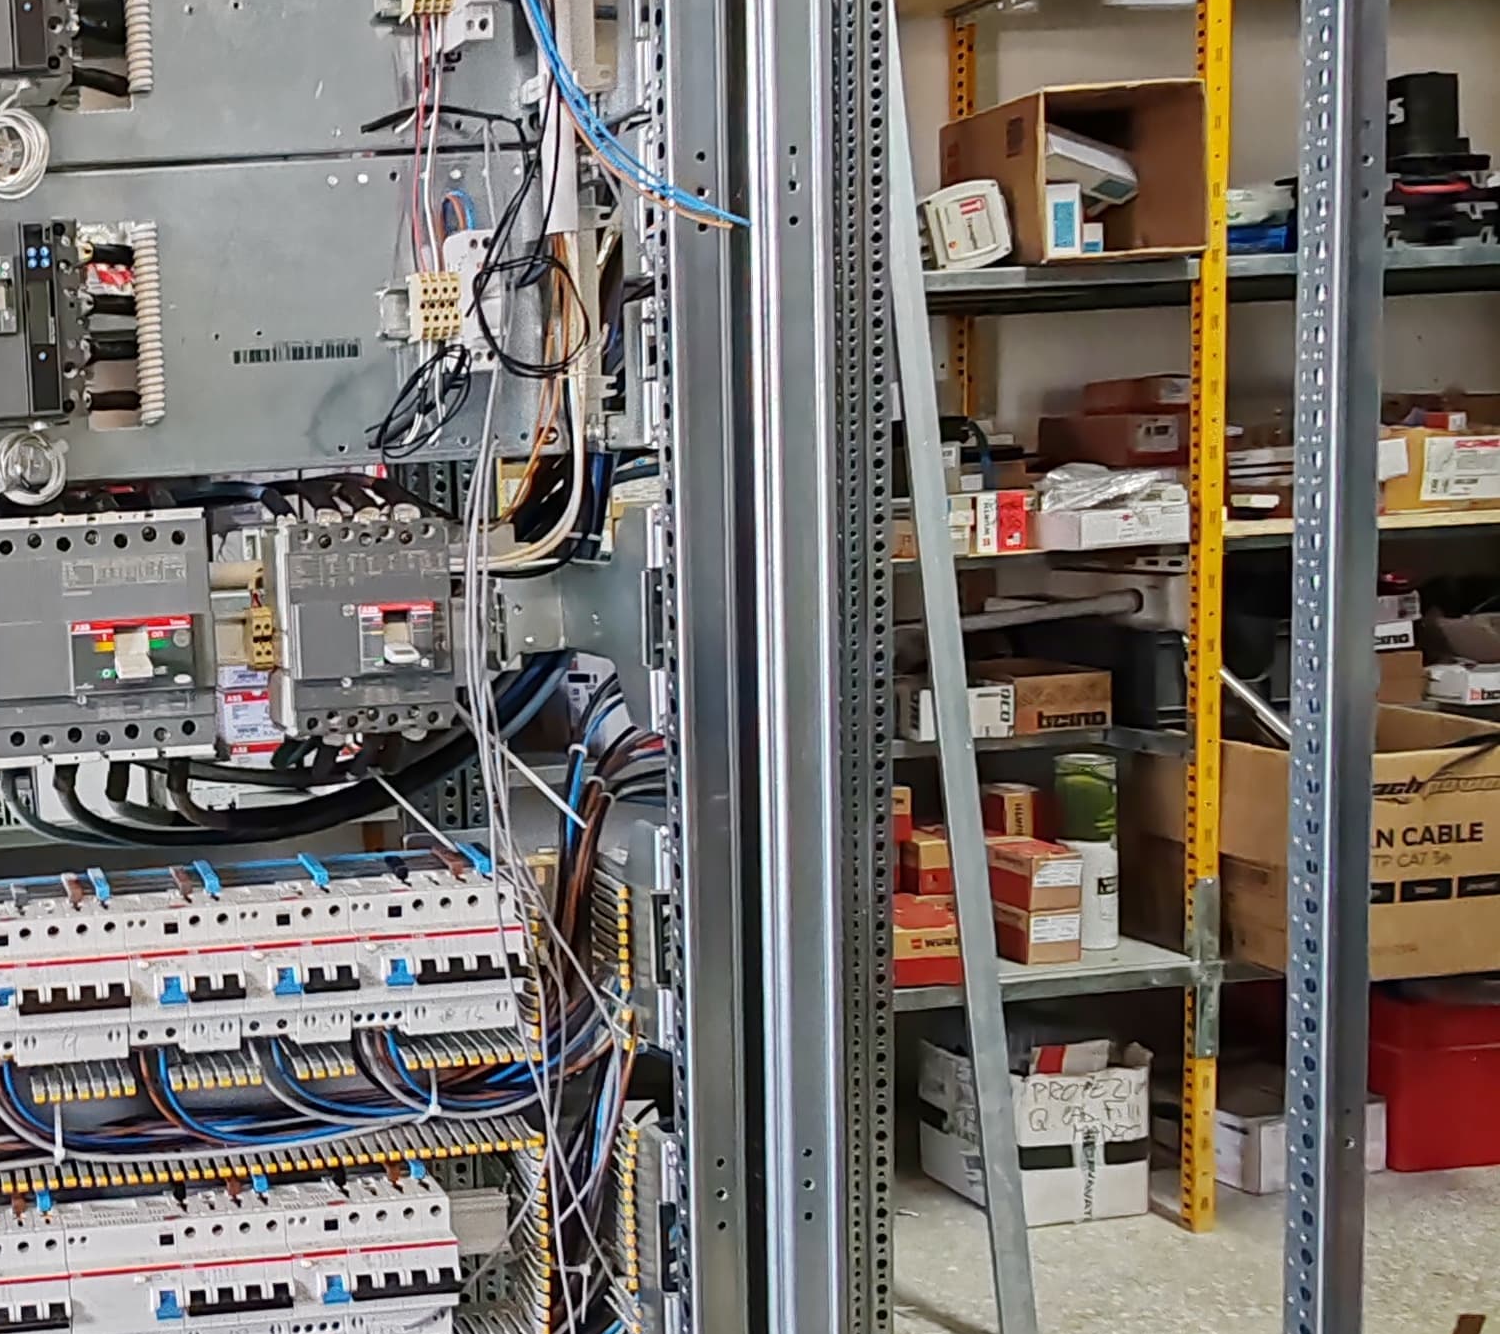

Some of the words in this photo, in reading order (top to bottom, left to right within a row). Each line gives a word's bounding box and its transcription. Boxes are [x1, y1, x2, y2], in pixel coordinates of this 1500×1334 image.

[1372, 827, 1394, 848] N
[1402, 821, 1484, 846] CABLE
[1373, 854, 1393, 868] TP
[1398, 852, 1427, 868] CAT
